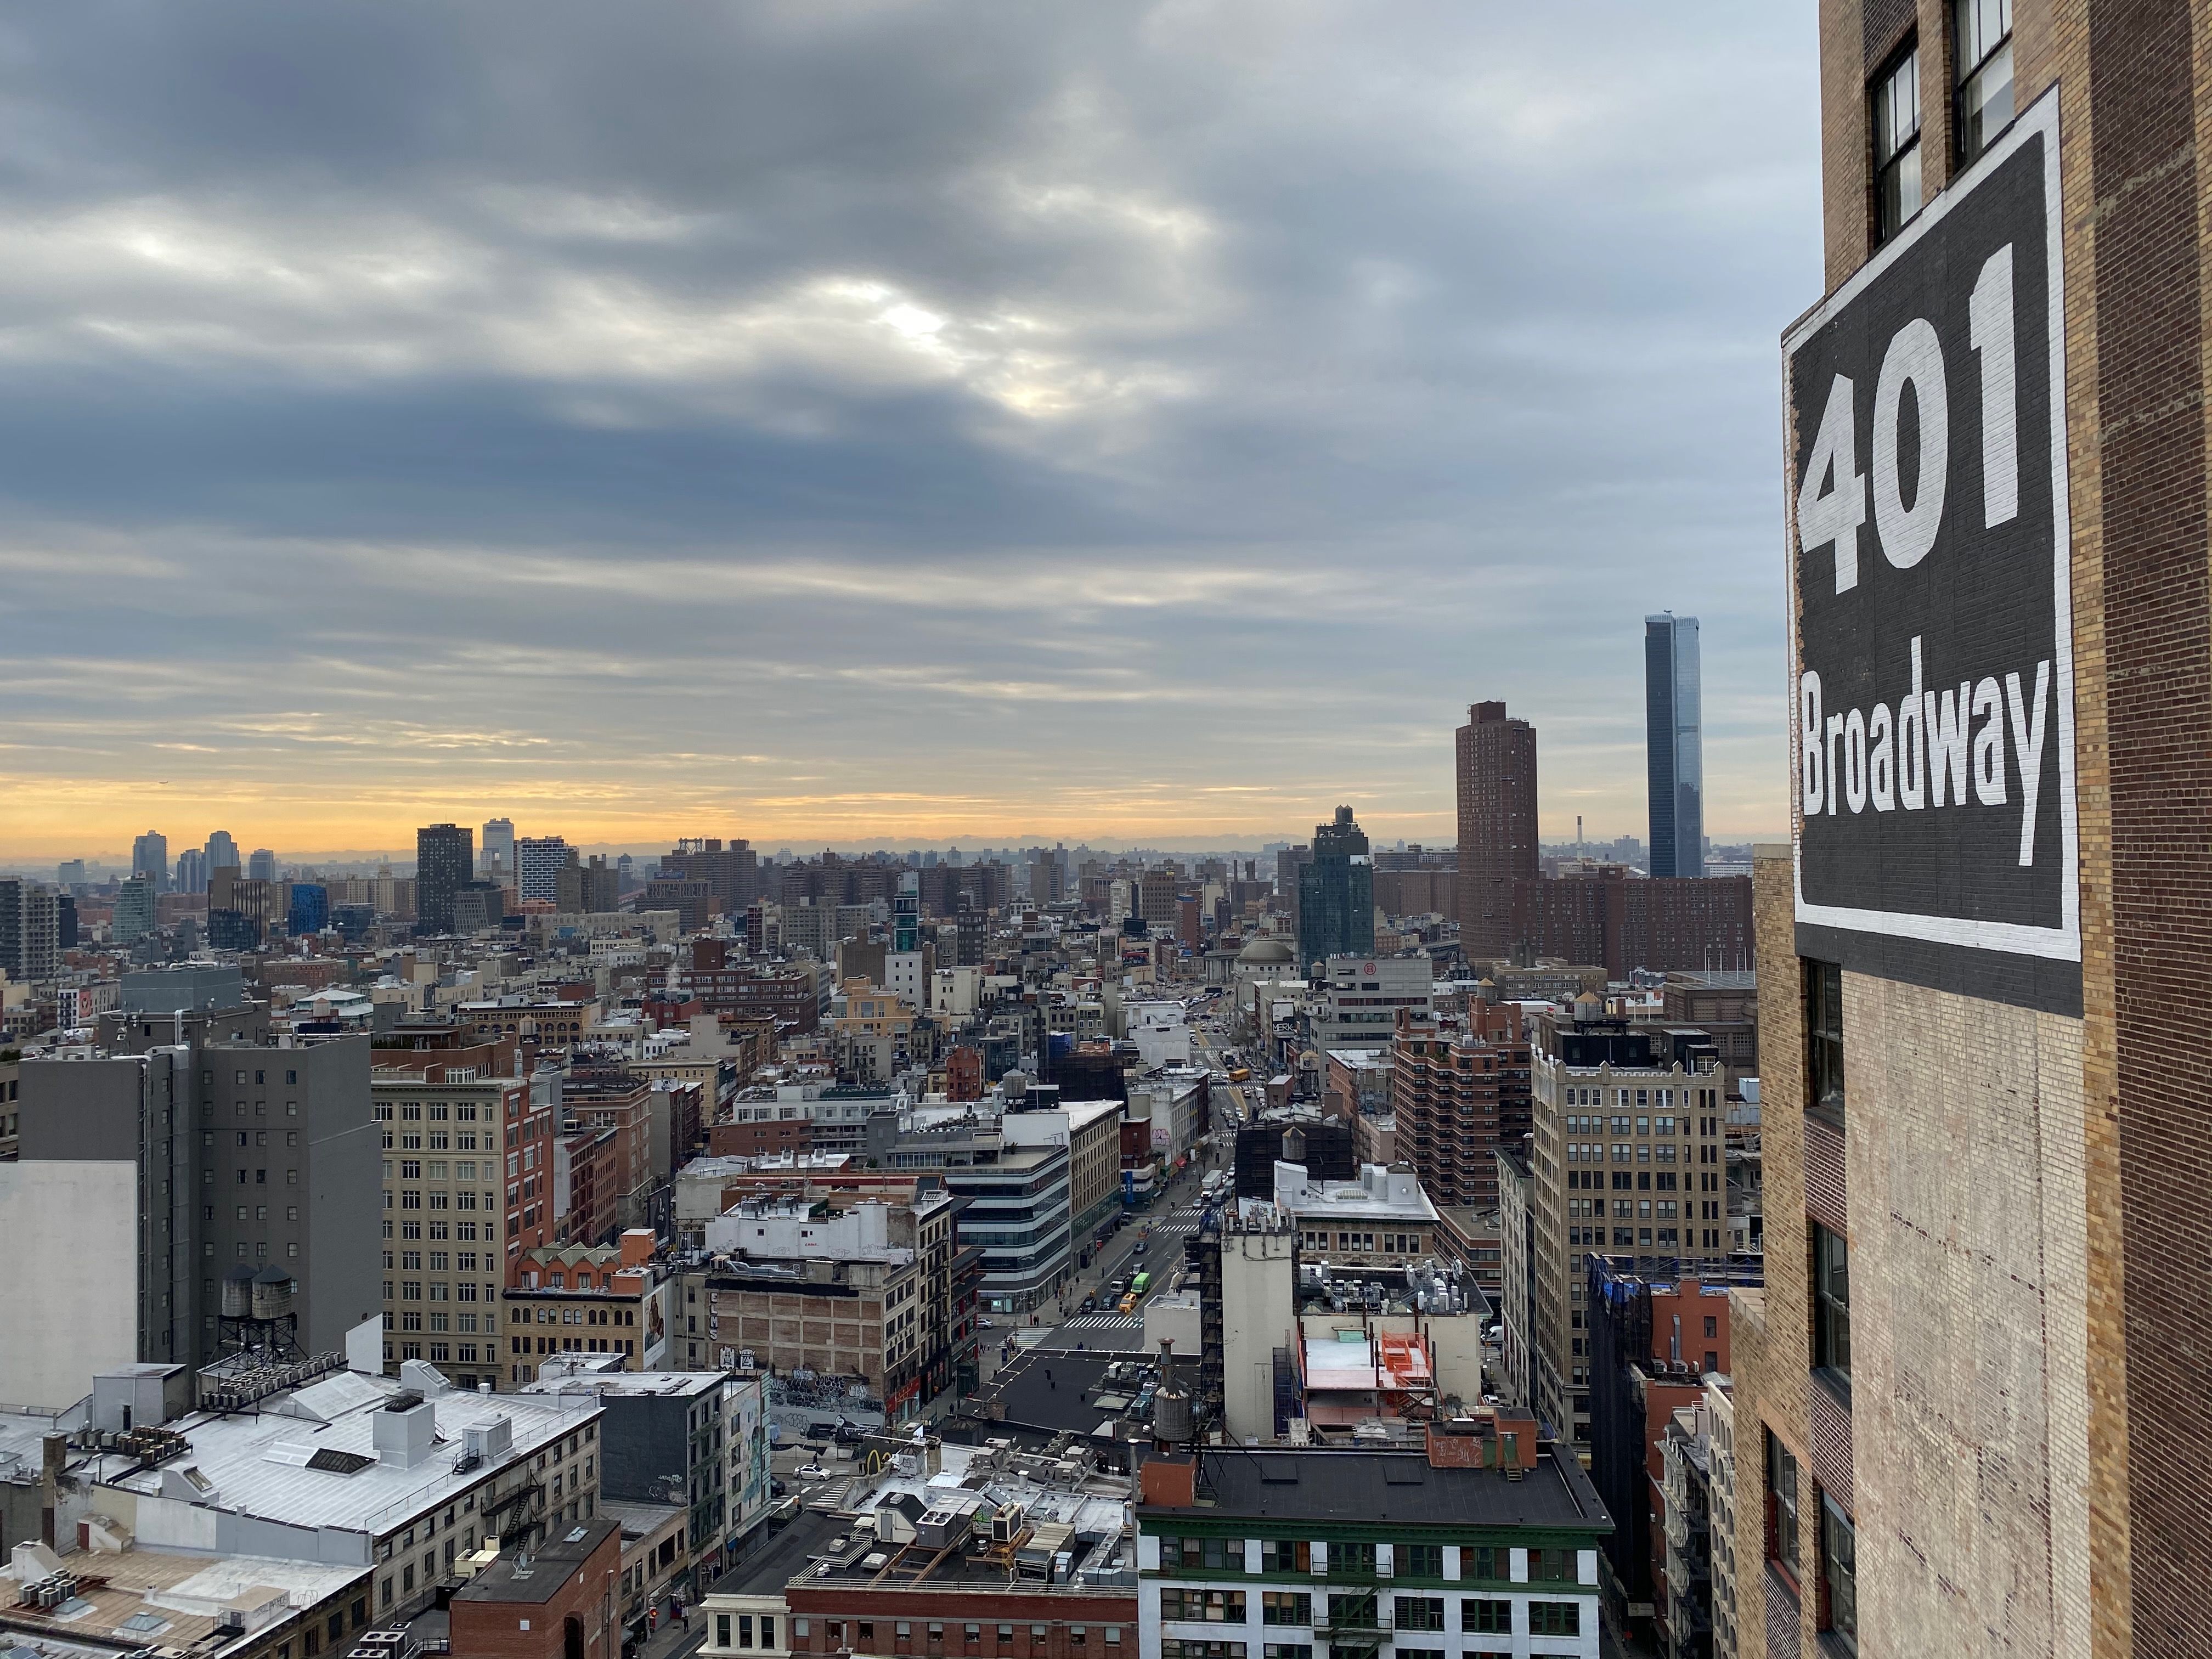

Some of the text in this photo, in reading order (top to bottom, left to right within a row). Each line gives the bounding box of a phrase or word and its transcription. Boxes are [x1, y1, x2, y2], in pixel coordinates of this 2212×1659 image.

[1798, 242, 2019, 595] 401
[1801, 635, 2051, 867] Broadway
[1273, 1023, 1293, 1031] MERK
